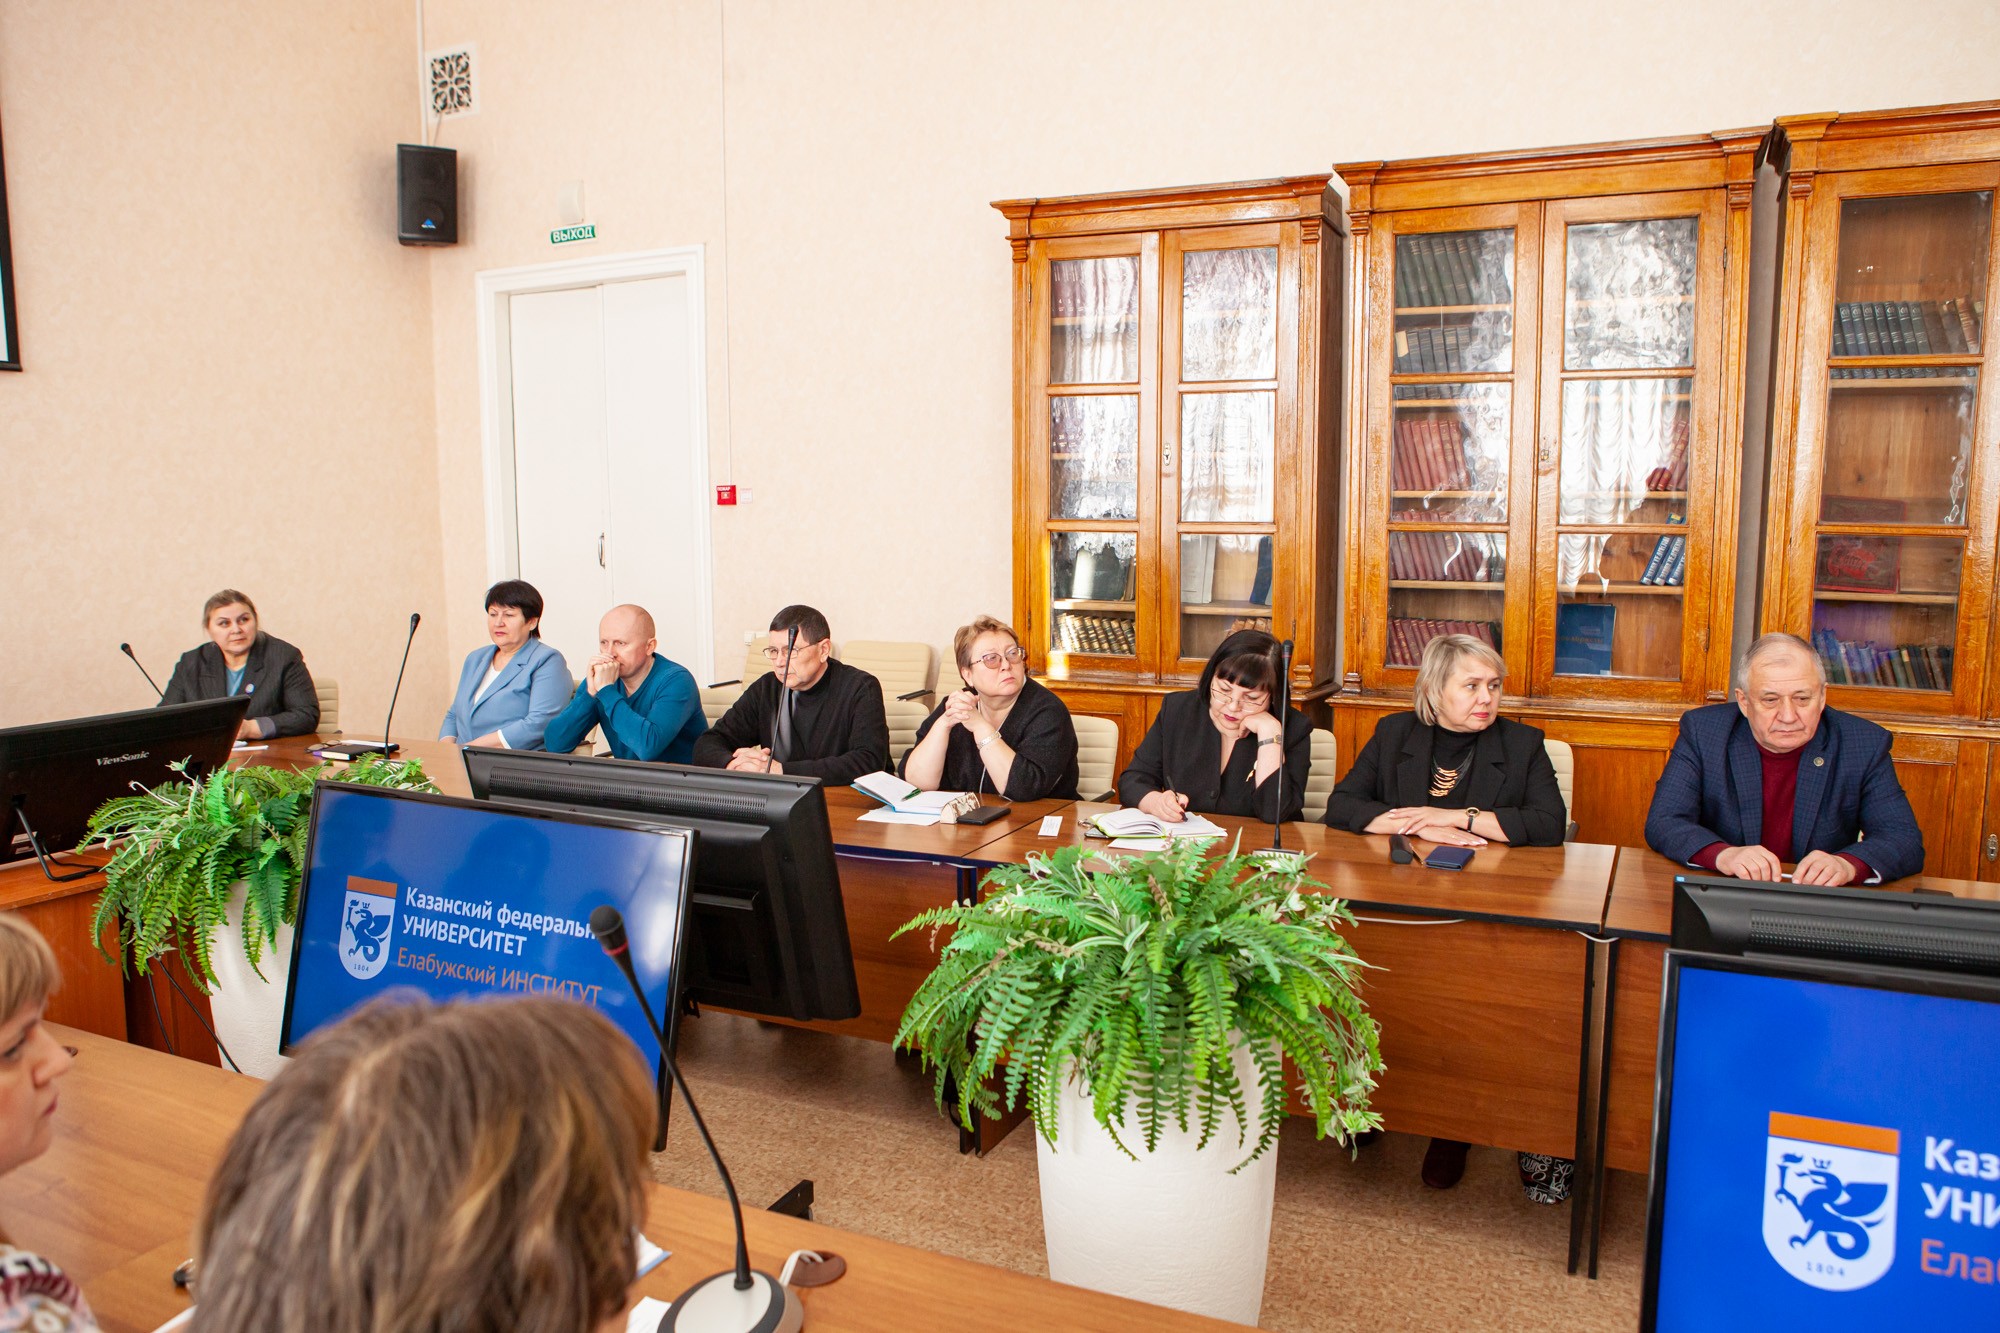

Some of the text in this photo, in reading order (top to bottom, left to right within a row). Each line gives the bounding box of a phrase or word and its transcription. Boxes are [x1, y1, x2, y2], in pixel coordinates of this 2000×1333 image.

[553, 226, 593, 242] ВЫХОД
[96, 751, 150, 766] ViewSonic
[405, 886, 597, 940] Казанский федеральн
[403, 914, 527, 956] УНИВЕРСИТЕТ
[353, 963, 369, 972] 1804
[397, 947, 602, 1007] Елабужский ИНСТИТУТ
[1806, 1261, 1845, 1277] 1804
[1920, 1238, 2000, 1285] Ела
